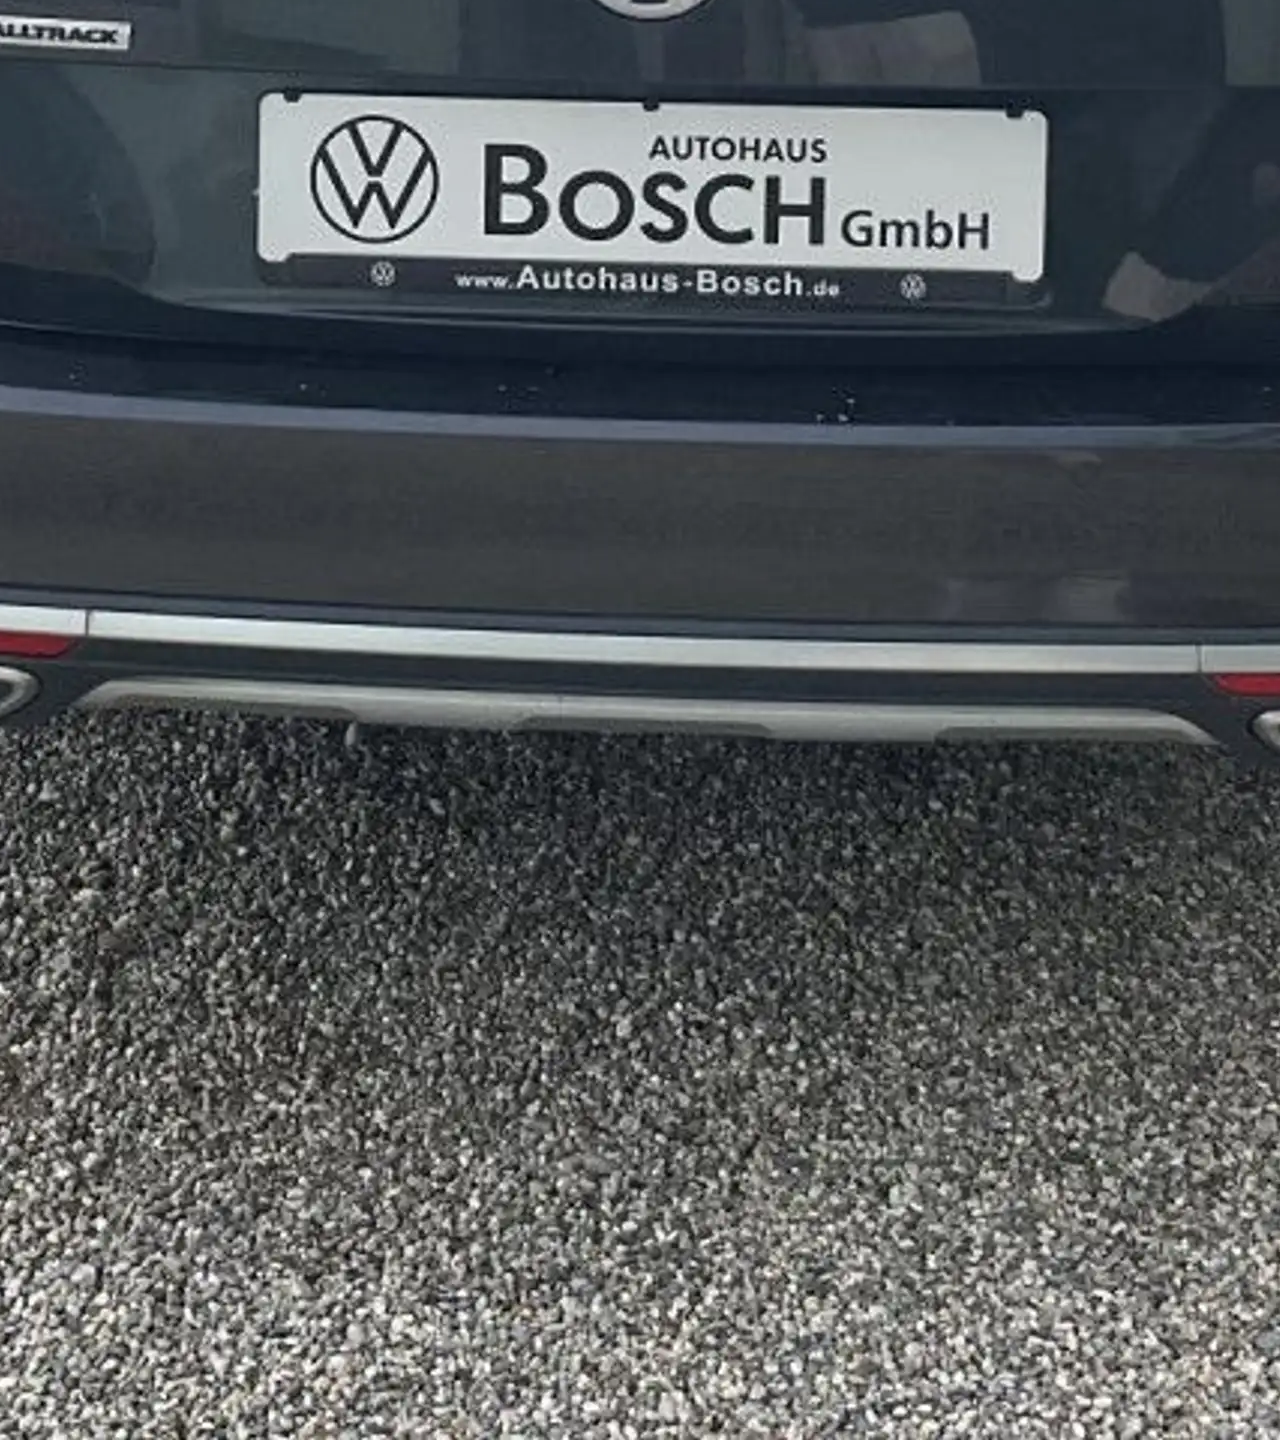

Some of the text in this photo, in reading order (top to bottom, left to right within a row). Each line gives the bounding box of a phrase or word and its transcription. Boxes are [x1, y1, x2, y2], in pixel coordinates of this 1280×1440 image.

[648, 134, 828, 164] AUTOHAUS
[483, 142, 827, 248] BOSCH
[841, 209, 990, 251] GmbH
[455, 263, 841, 298] www.Autohaus-Bosch.de
